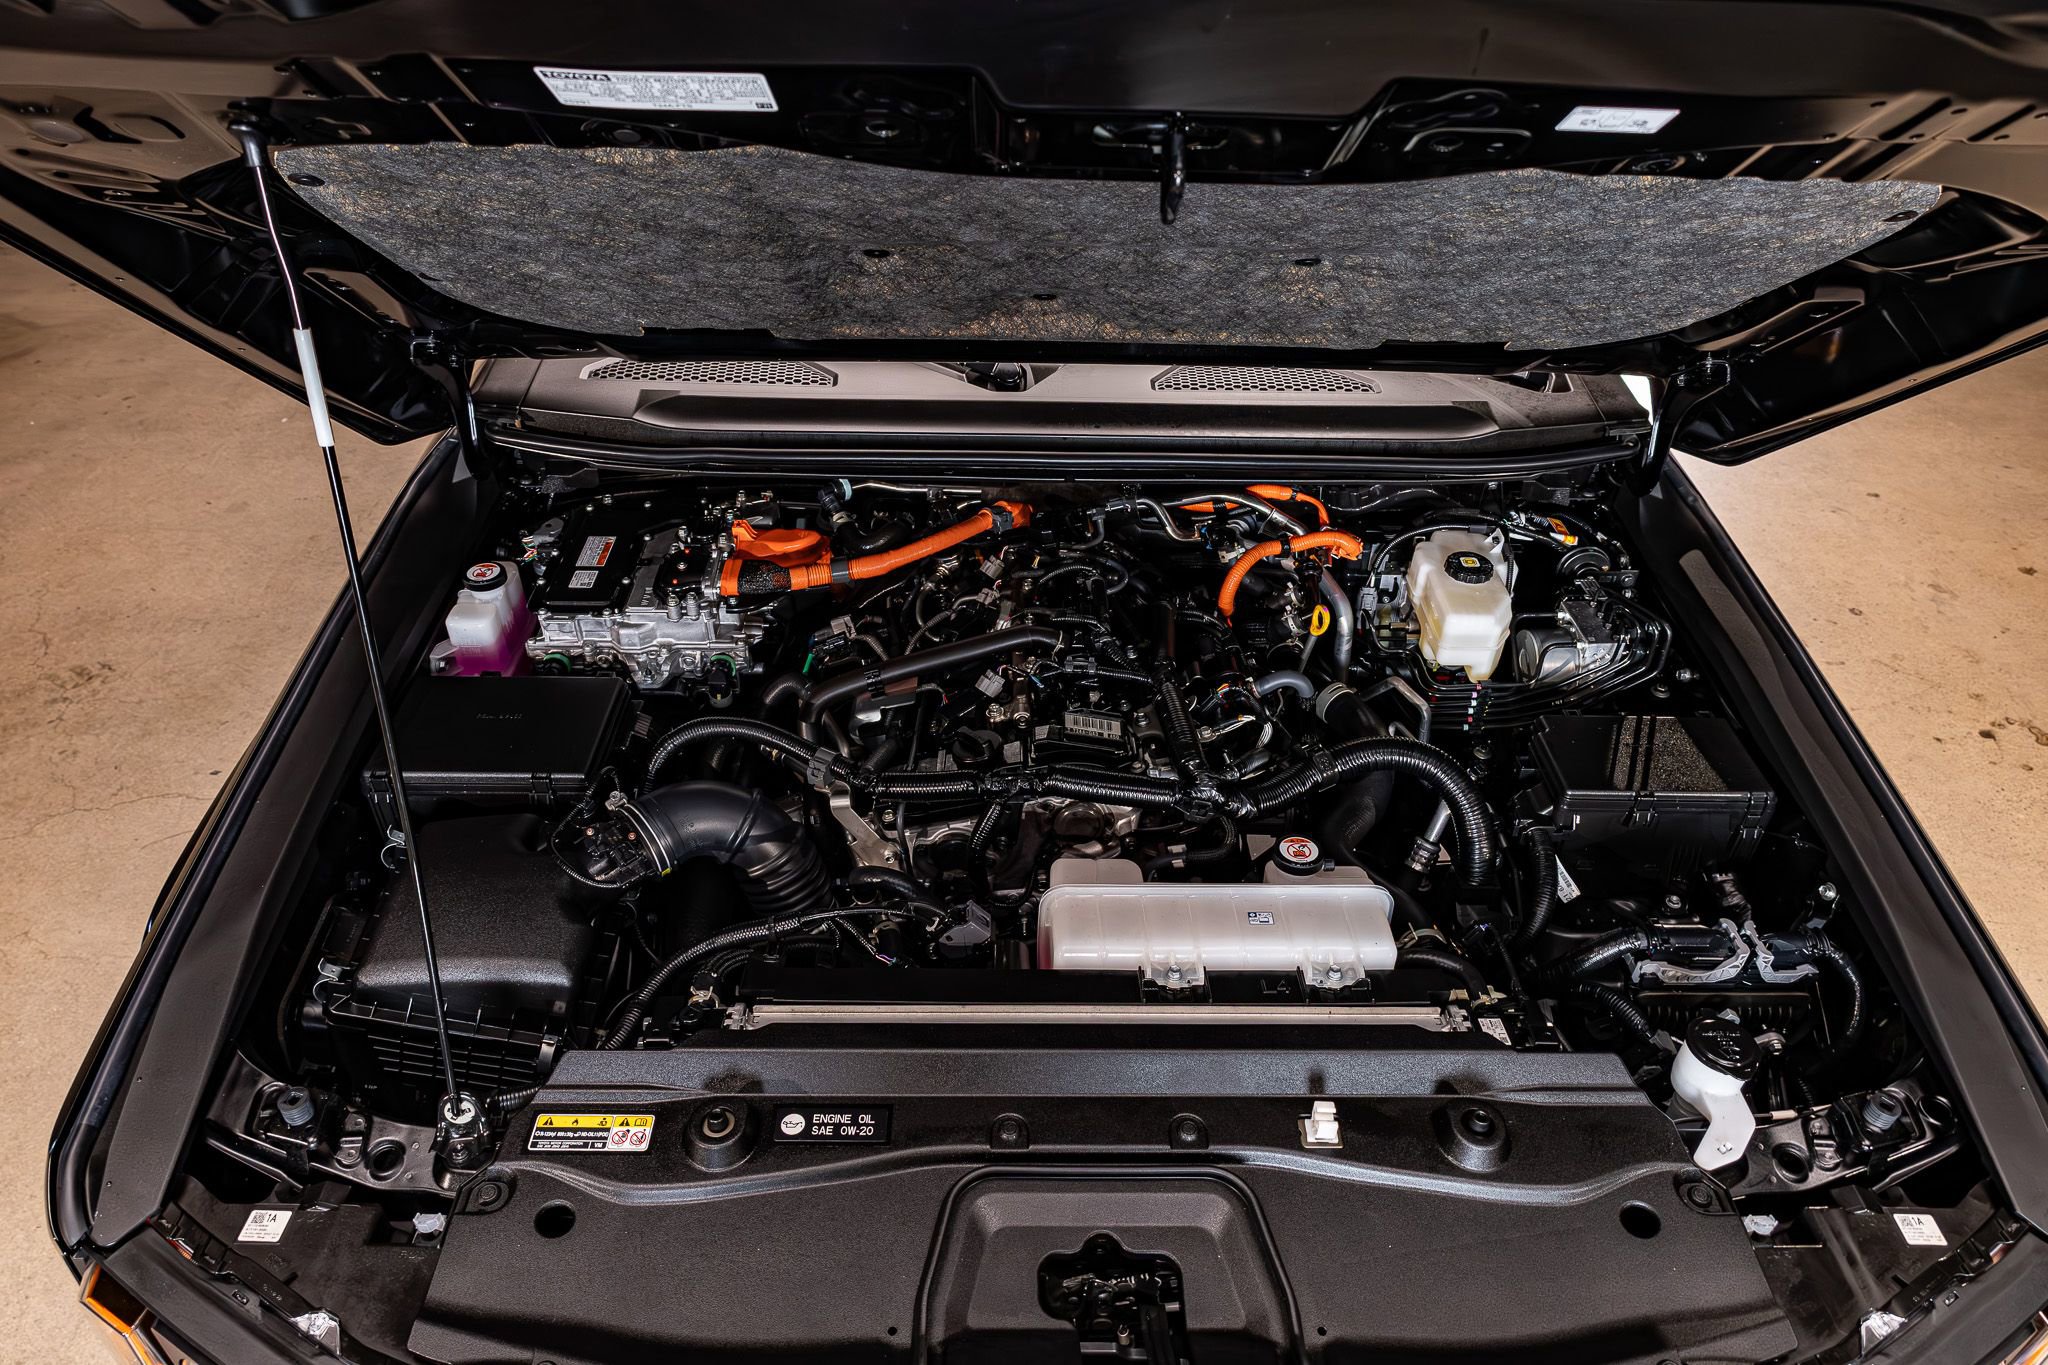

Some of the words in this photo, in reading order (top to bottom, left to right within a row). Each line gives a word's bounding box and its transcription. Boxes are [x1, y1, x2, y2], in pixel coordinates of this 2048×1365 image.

[539, 70, 612, 81] TOYOTA
[812, 1113, 852, 1124] ENGINE
[858, 1114, 875, 1124] OIL
[811, 1126, 834, 1136] SAE
[840, 1126, 874, 1136] 0W-20
[266, 1213, 278, 1223] 1A
[1911, 1216, 1925, 1226] 1A
